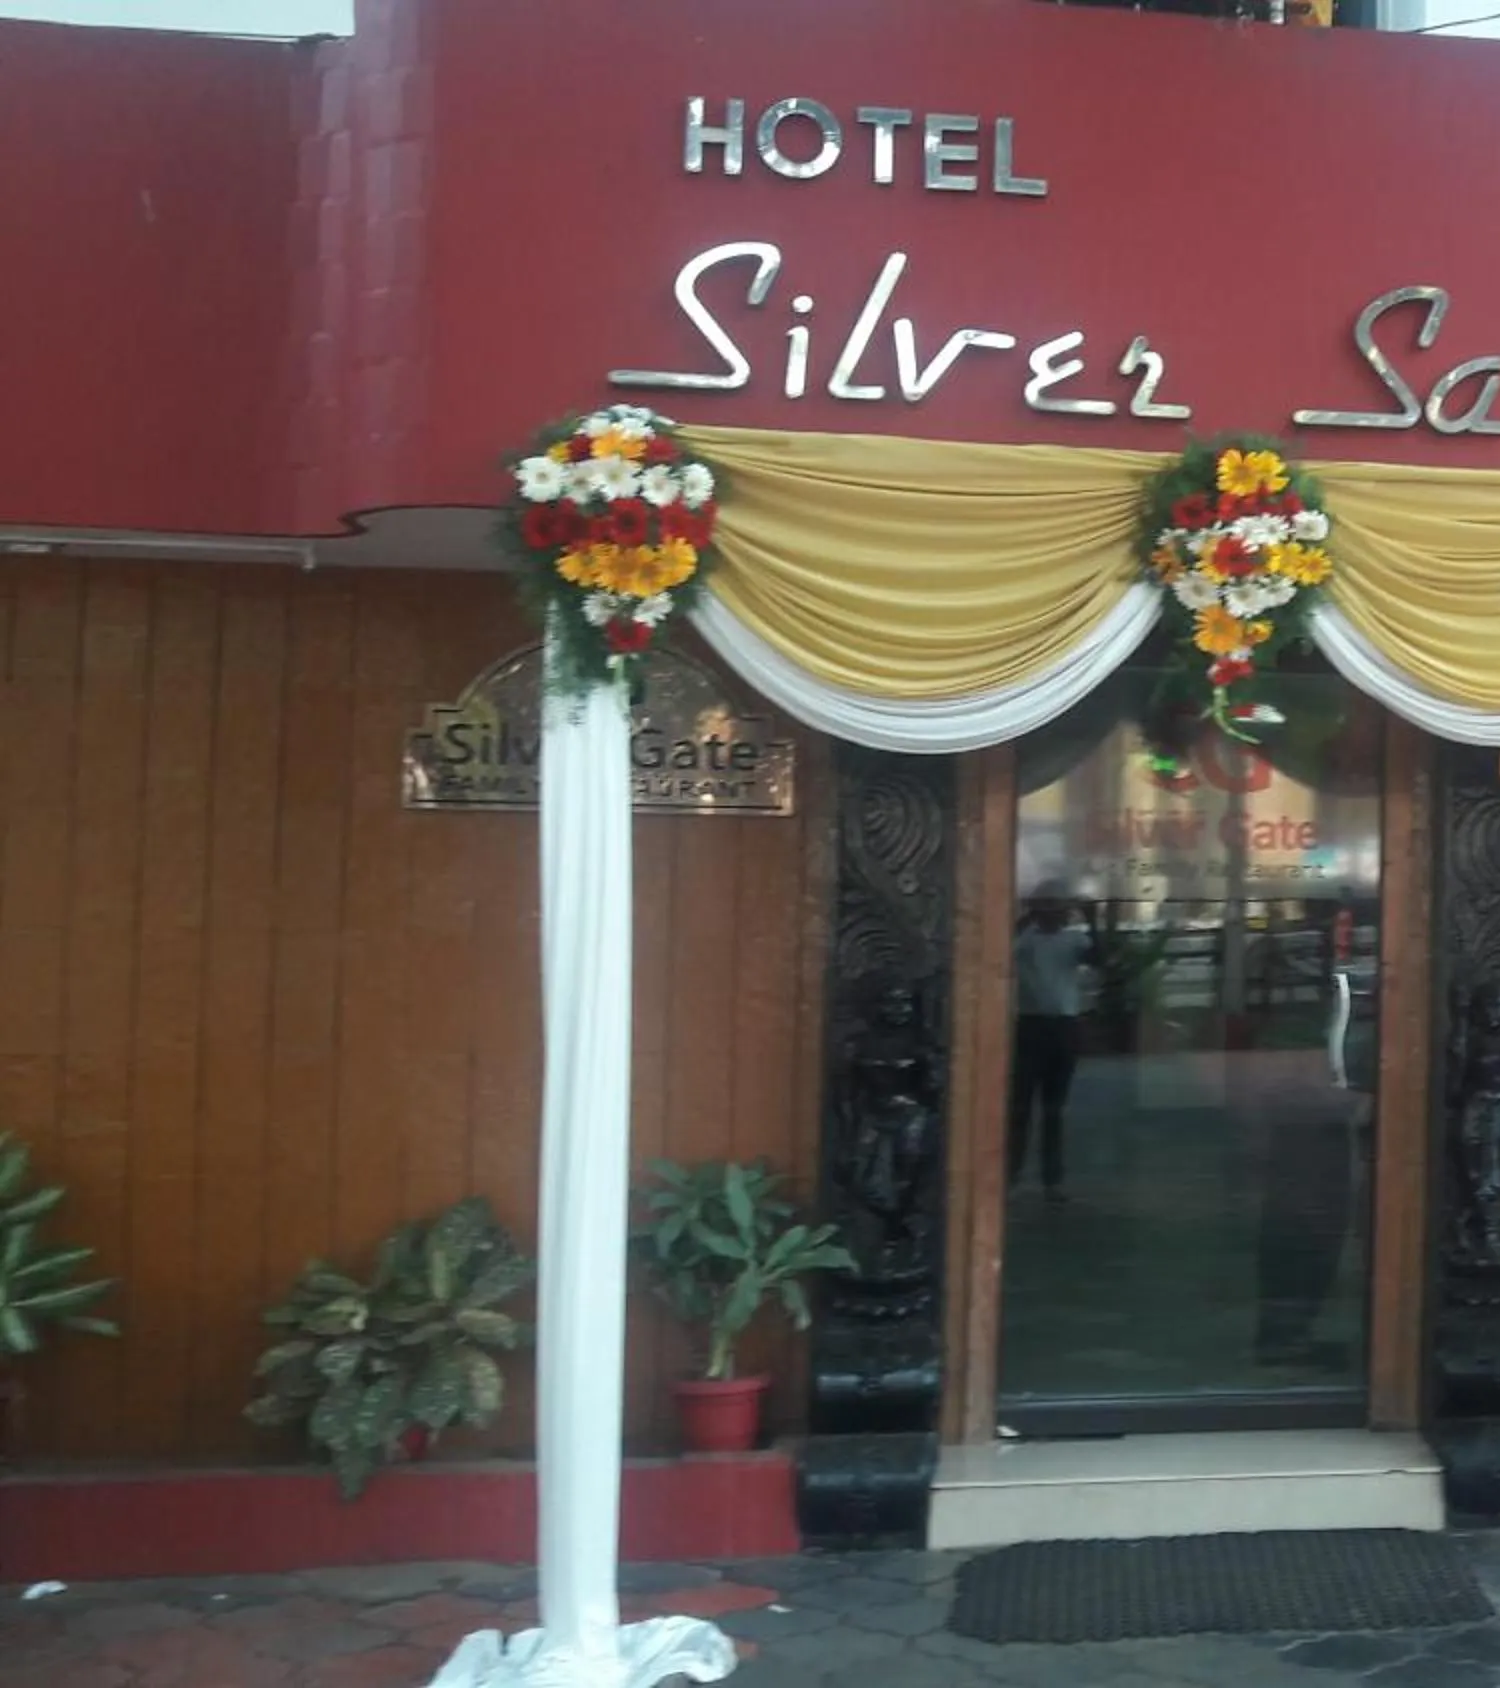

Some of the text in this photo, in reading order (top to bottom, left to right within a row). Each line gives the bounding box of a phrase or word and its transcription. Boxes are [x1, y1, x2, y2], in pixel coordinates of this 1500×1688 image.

[683, 96, 1048, 196] HOTEL
[444, 721, 760, 770] Silv Gate
